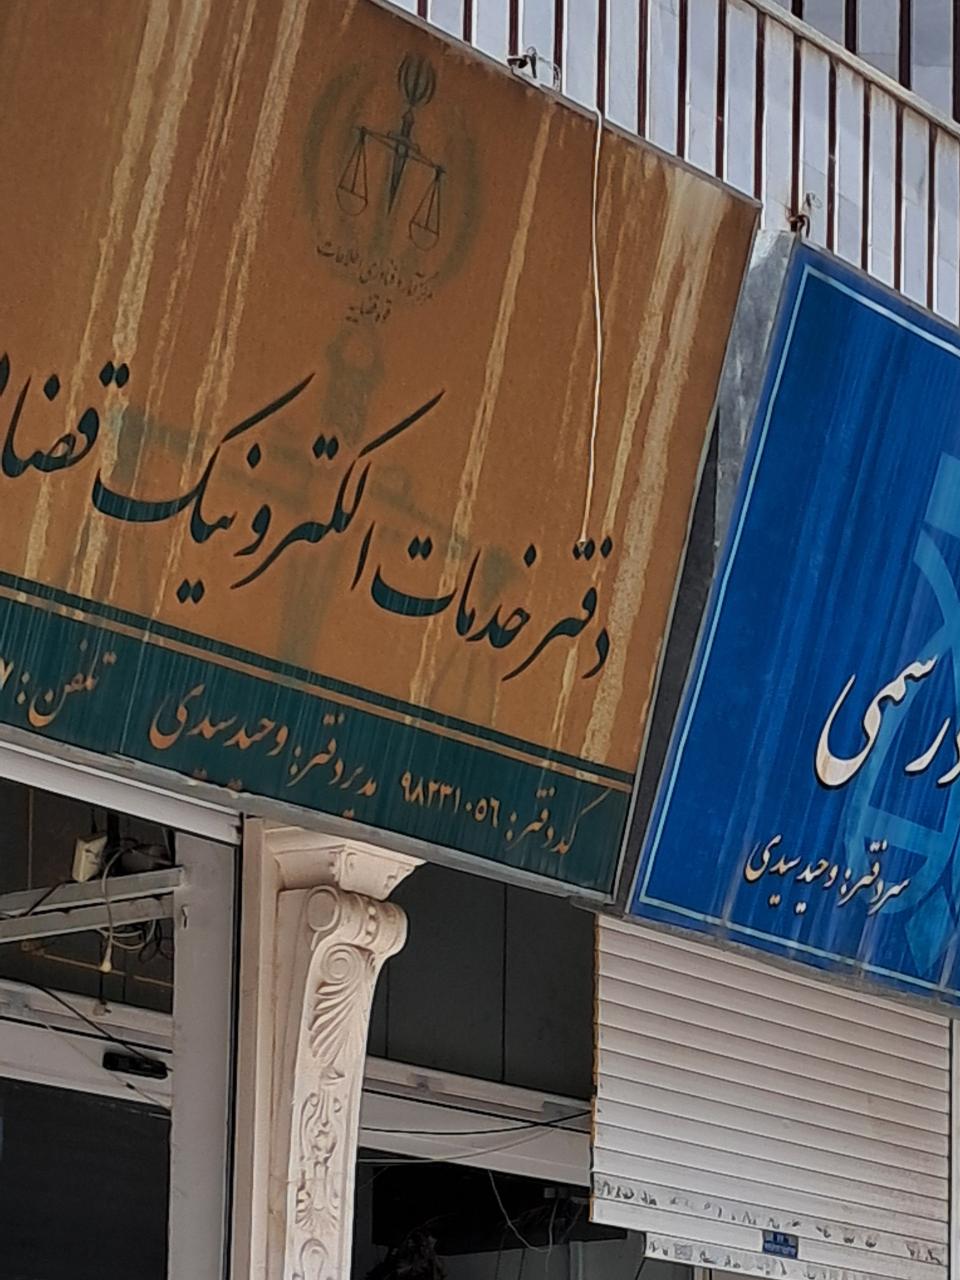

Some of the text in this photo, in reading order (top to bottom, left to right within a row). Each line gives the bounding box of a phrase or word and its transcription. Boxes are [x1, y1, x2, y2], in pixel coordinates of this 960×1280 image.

[91, 372, 446, 604] الکترونیک
[371, 535, 537, 649] خدمات
[502, 535, 613, 681] دفتر
[149, 683, 237, 782] سیدی
[223, 717, 289, 790] وحید
[815, 654, 951, 788] رسمی
[340, 765, 377, 819] مدیر
[550, 788, 612, 855] کد
[744, 834, 801, 905] سیدی
[794, 858, 839, 914] وحید
